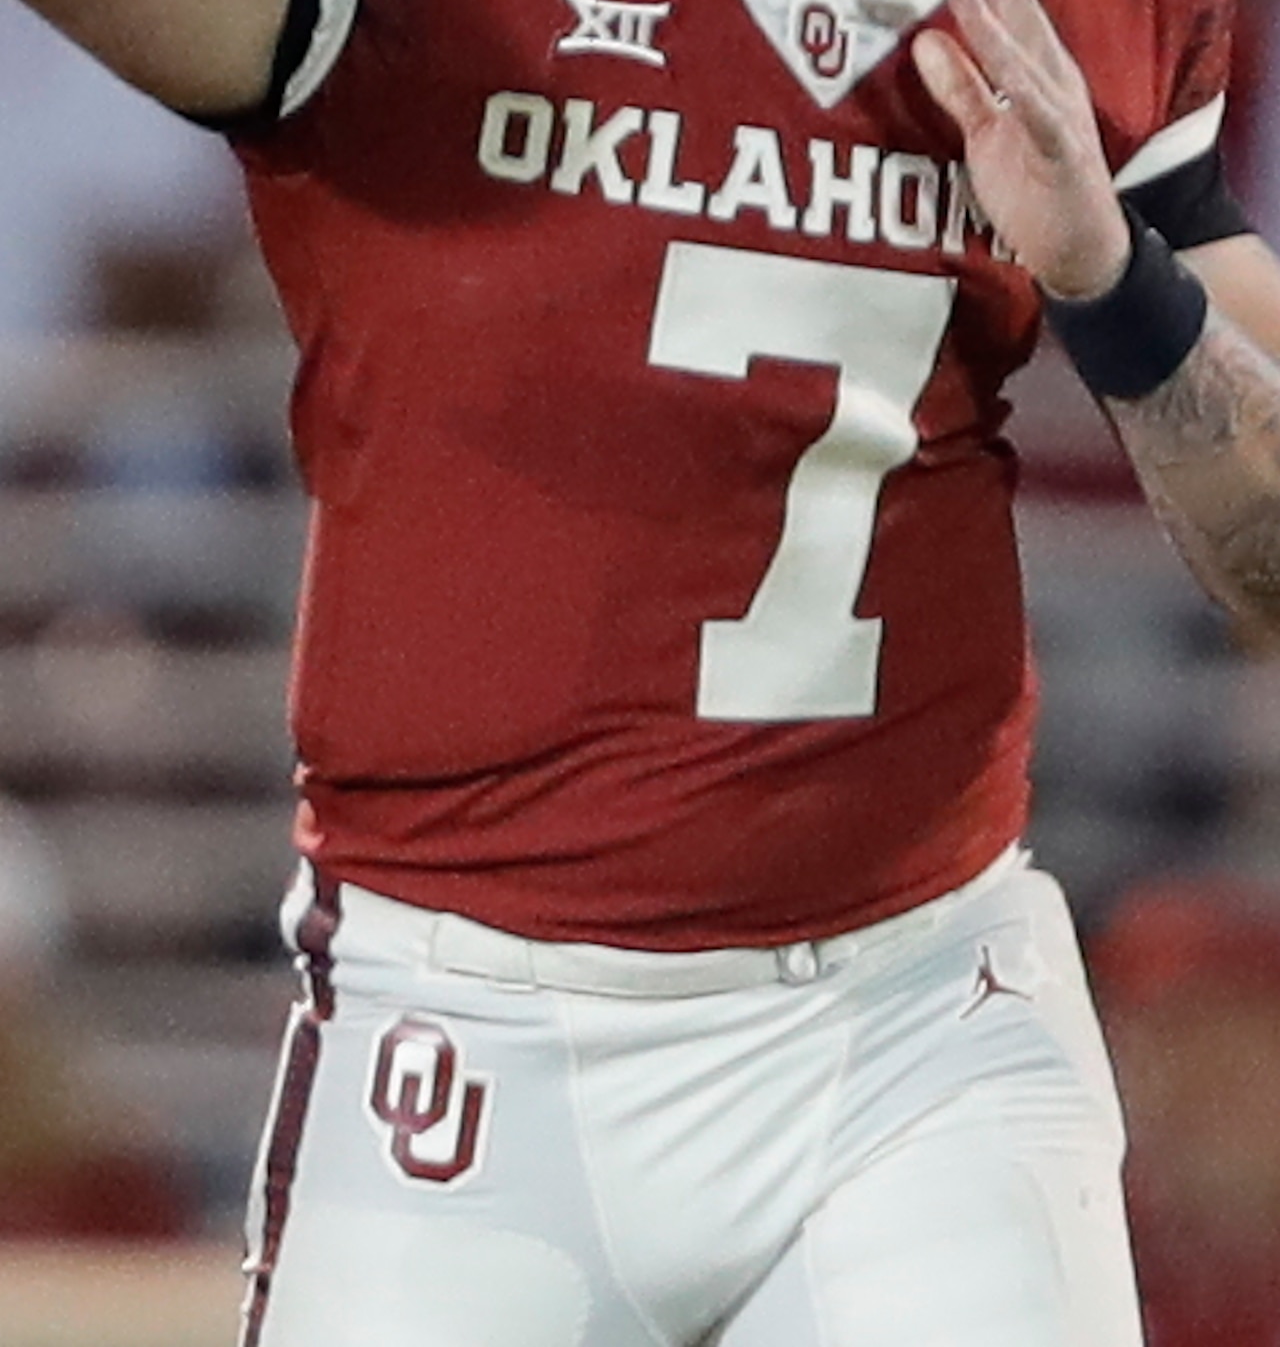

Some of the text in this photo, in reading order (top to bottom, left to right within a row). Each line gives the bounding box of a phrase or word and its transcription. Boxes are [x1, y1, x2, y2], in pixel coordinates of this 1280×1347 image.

[800, 4, 848, 78] OU
[648, 241, 958, 719] 7
[368, 1015, 486, 1184] OU
